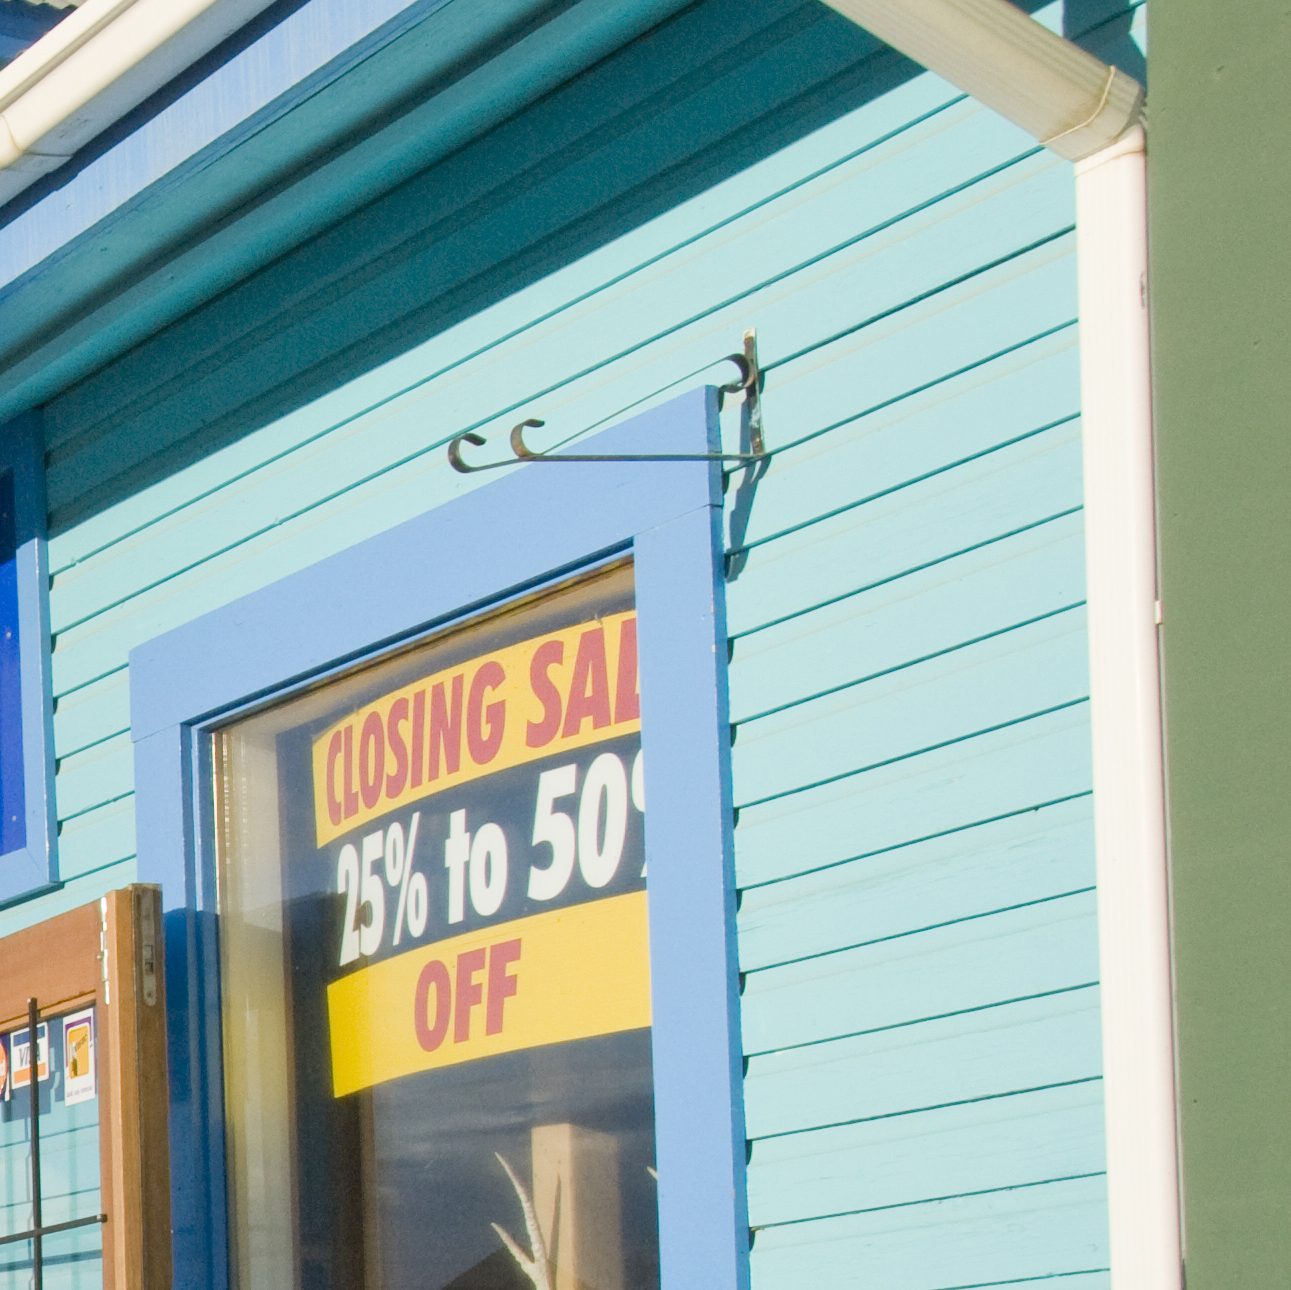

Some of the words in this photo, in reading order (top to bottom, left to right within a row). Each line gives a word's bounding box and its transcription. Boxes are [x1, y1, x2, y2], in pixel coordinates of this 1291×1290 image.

[326, 660, 507, 826] CLOSING
[336, 811, 428, 967] 25%
[445, 808, 508, 925] to
[19, 1043, 40, 1067] VIA
[414, 938, 522, 1053] OFF
